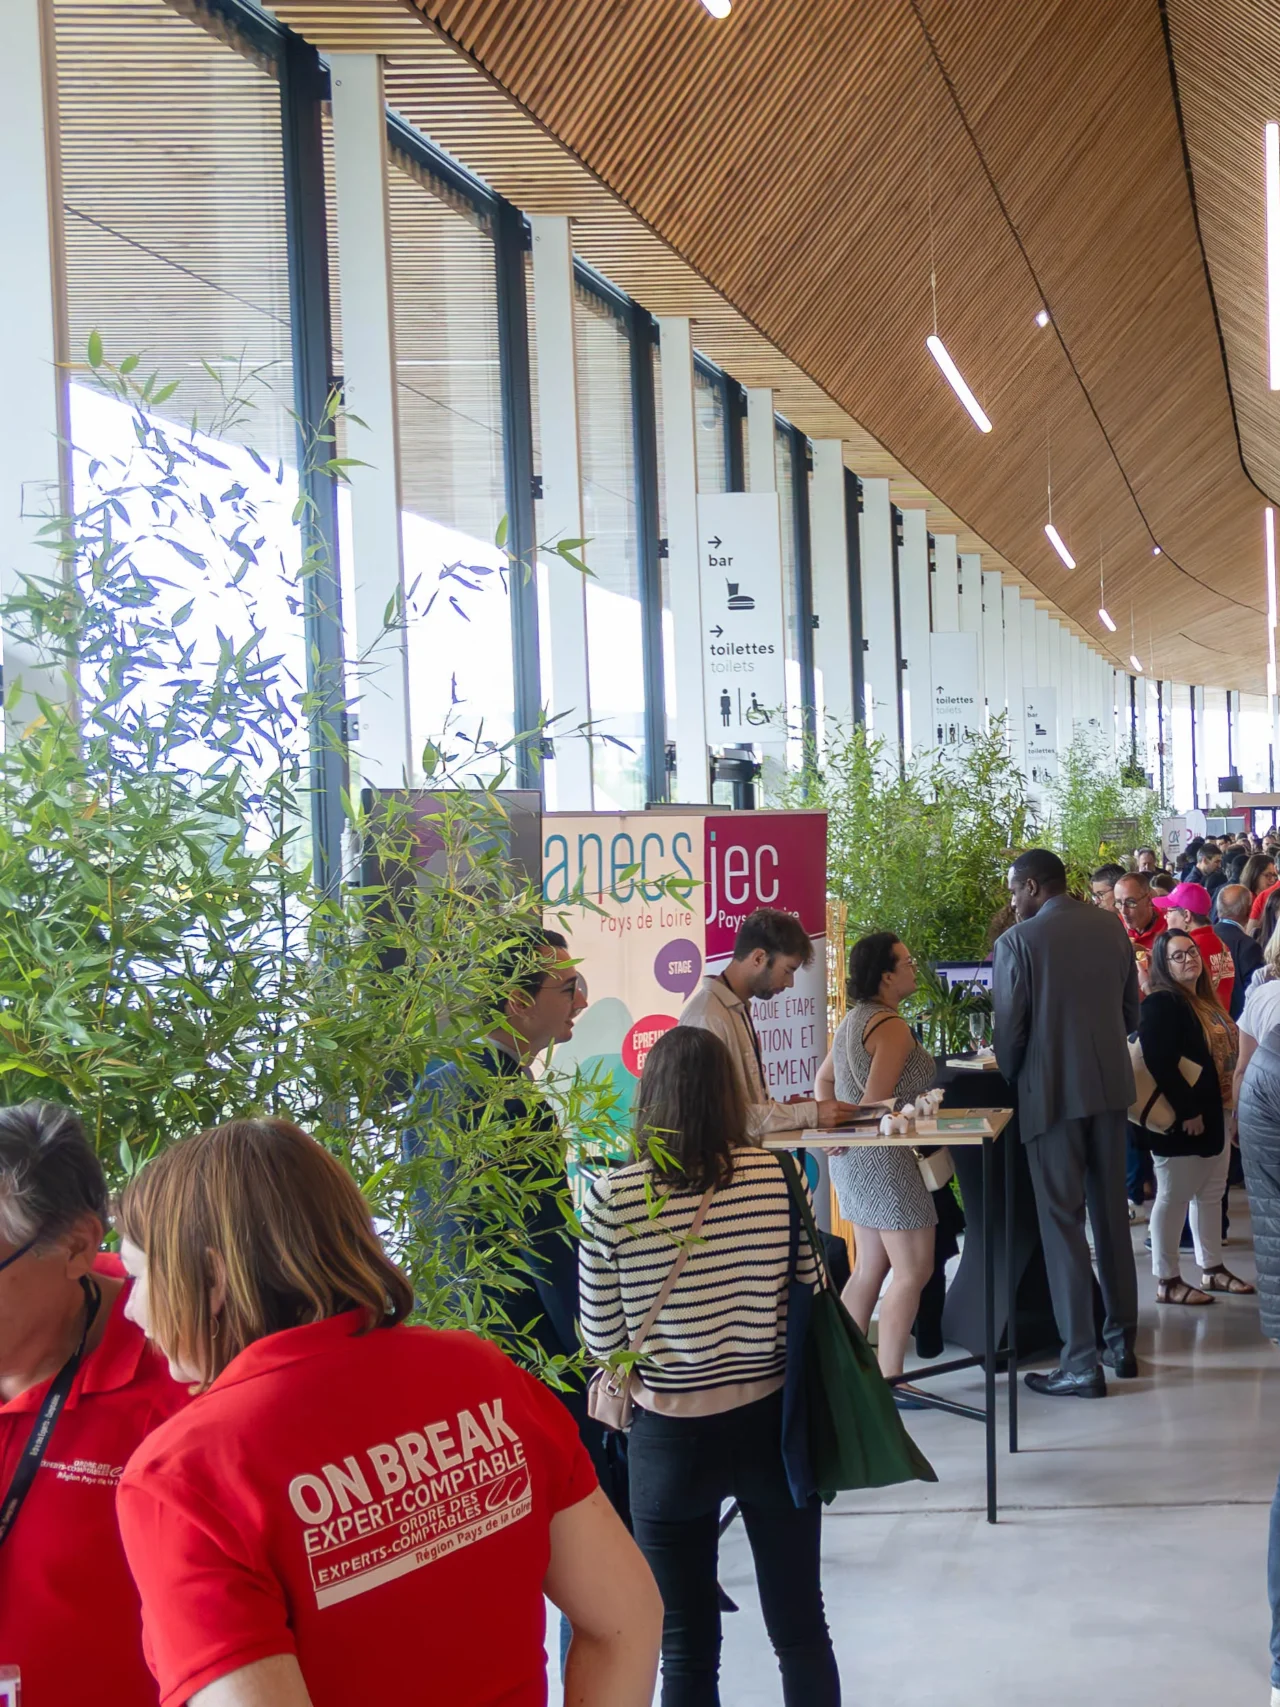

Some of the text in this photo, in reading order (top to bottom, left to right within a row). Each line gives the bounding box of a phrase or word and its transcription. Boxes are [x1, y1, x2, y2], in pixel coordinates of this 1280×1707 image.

[708, 554, 734, 567] bar
[710, 642, 775, 656] toilettes
[711, 660, 755, 673] toilets
[936, 696, 974, 704] toilettes
[936, 706, 962, 714] toilets
[542, 832, 693, 906] anecs
[706, 831, 780, 925] jec
[600, 906, 692, 938] Pays de Loire
[718, 910, 747, 933] Pays
[668, 960, 692, 975] STAGE
[753, 996, 816, 1021] AQUE ÉTAPE
[757, 1024, 815, 1053] TION ET
[288, 1397, 520, 1525] ON BREAK
[57, 1470, 80, 1481] Région
[303, 1442, 526, 1555] EXPERT-COMPTABLE
[400, 1491, 478, 1535] ORDRE DES
[318, 1503, 482, 1584] EXPERTS-COMPTABLES
[415, 1501, 531, 1564] Région Pays de la Loire
